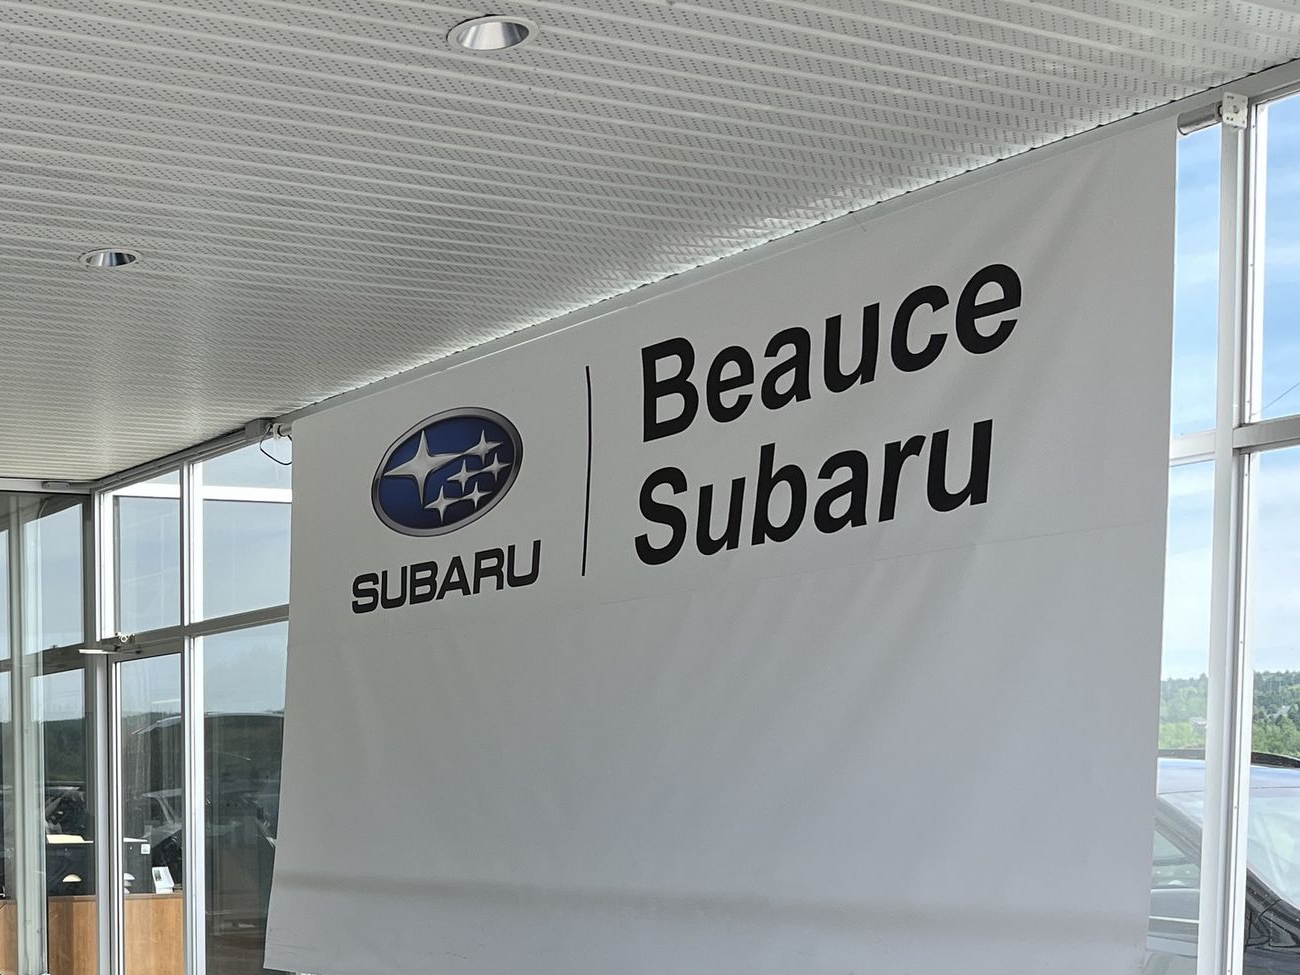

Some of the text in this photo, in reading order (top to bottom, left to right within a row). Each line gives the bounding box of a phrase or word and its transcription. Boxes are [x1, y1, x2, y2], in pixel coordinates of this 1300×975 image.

[641, 263, 1023, 442] Beauce
[635, 419, 995, 566] Subaru
[352, 540, 542, 615] SUBARU
